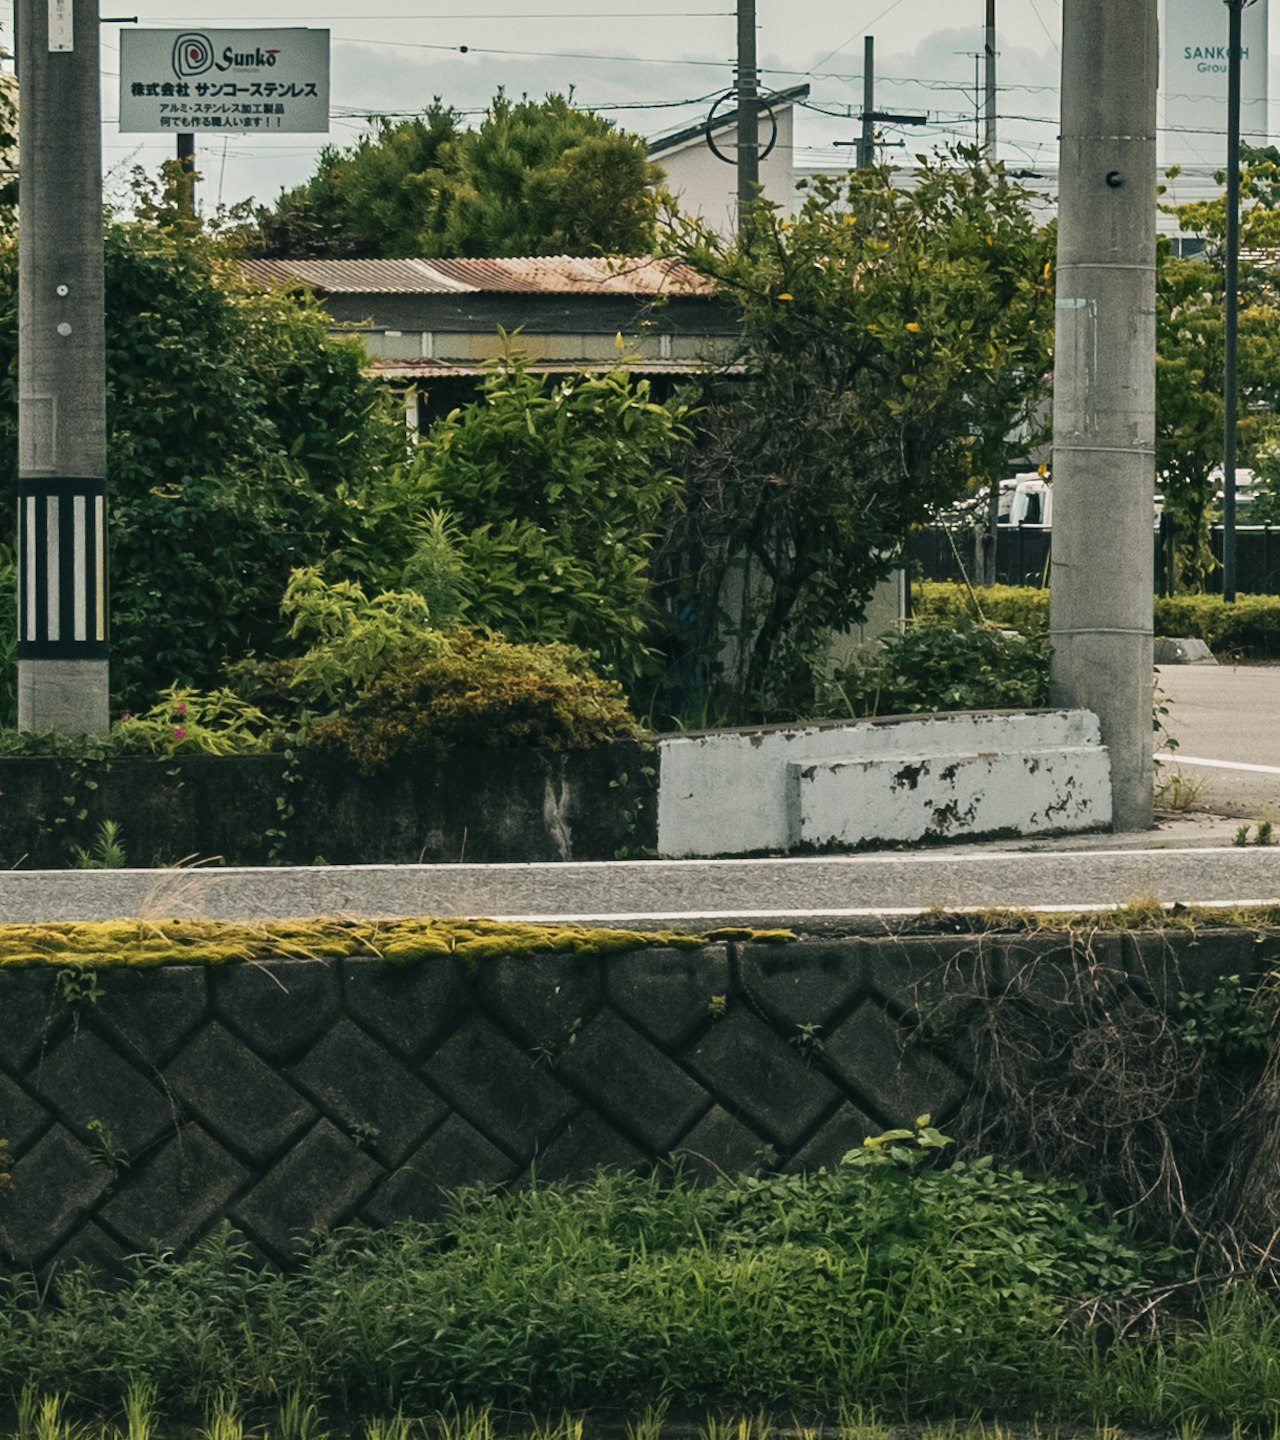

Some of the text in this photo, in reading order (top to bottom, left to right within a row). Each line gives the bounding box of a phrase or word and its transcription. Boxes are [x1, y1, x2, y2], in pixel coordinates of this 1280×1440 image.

[1184, 46, 1249, 60] SANKH
[131, 82, 318, 98] 株式会社 サンコーステンレス
